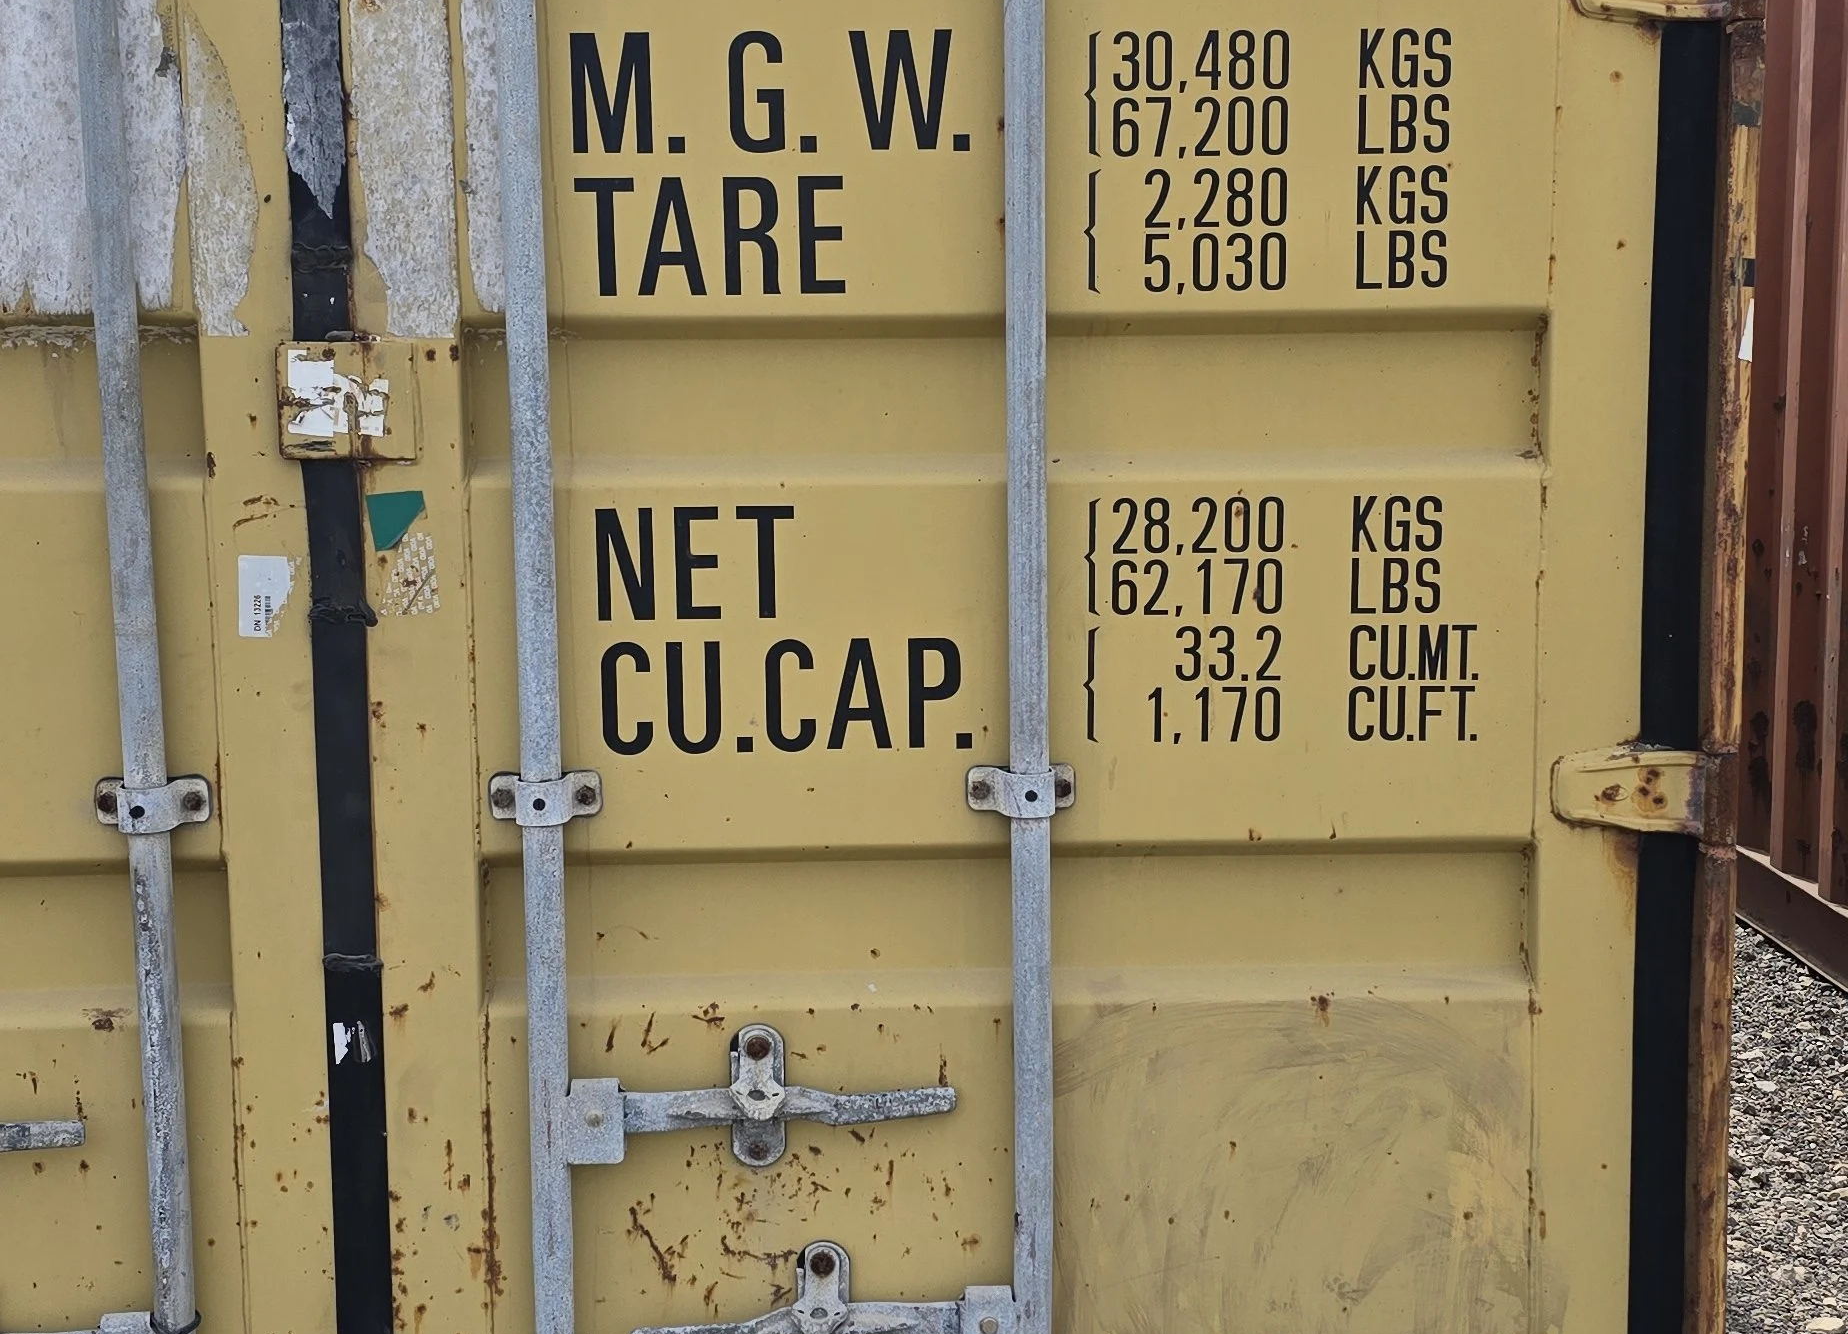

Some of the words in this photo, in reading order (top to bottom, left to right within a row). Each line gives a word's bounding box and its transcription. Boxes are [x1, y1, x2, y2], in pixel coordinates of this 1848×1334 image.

[569, 31, 686, 154] M.
[728, 30, 818, 154] G.
[847, 28, 971, 152] W.
[1112, 29, 1290, 94] 30,480
[1358, 27, 1452, 89] KGS
[1112, 95, 1289, 159] 67,200
[1357, 93, 1450, 155] LBS
[1144, 167, 1288, 231] 2,280
[1356, 164, 1447, 225] KGS
[573, 175, 846, 297] TARE
[1144, 231, 1287, 295] 5,030
[1355, 229, 1448, 290] LBS
[1112, 496, 1285, 556] 28,200
[1351, 495, 1443, 553] KGS
[594, 505, 795, 622] NET
[1111, 558, 1283, 618] 62,170
[1350, 557, 1441, 614] LBS
[253, 619, 262, 632] DN
[1175, 624, 1282, 682] 33.2
[1349, 624, 1479, 681] CU.MT.
[600, 637, 973, 756] CU.CAP.
[1147, 686, 1281, 745] 1,170
[1348, 685, 1478, 742] CU.FT.
